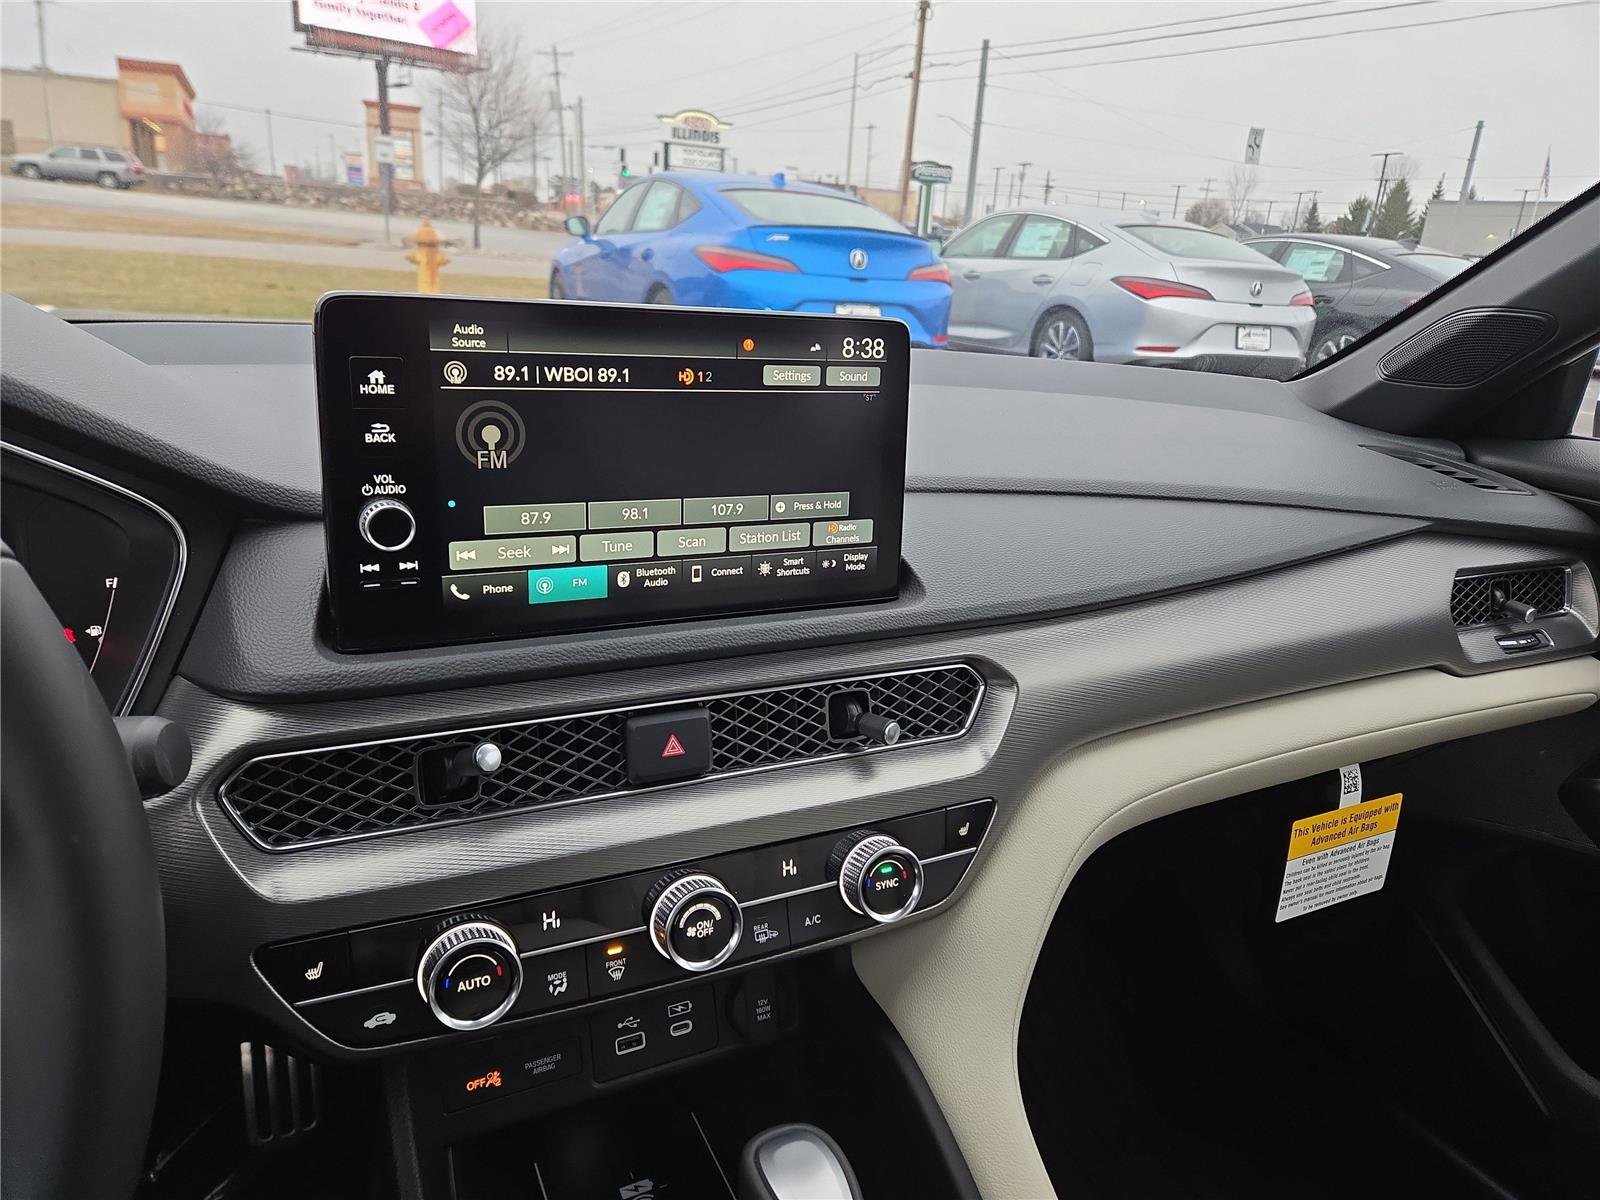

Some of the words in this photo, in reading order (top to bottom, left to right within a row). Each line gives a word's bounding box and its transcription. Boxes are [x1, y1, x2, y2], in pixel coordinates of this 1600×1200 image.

[453, 323, 484, 336] Audio
[451, 337, 486, 348] Source
[842, 337, 885, 359] 8:38
[494, 365, 529, 382] 89.1
[544, 366, 593, 383] WBOI
[597, 367, 630, 383] 89.1
[772, 369, 812, 383] Settings
[839, 370, 868, 382] Sound
[359, 383, 396, 395] HOME
[364, 432, 397, 444] BACK
[476, 450, 508, 470] FM
[373, 474, 395, 485] VOL
[374, 484, 407, 496] AUDIO
[711, 503, 744, 517] 107.9
[793, 501, 814, 511] Press
[815, 501, 822, 510] &
[823, 500, 842, 510] Hold
[520, 511, 552, 526] 87.9
[621, 507, 649, 521] 98.1
[839, 523, 857, 532] Radio
[678, 535, 706, 549] Scan
[739, 531, 779, 545] Station
[782, 530, 802, 542] List
[825, 534, 860, 544] Channels
[602, 539, 633, 553] Tune
[497, 545, 532, 560] Seek
[843, 552, 869, 563] Display
[783, 557, 805, 567] Smart
[845, 563, 866, 572] Mode
[636, 566, 677, 578] Bluetooth
[711, 566, 744, 577] Connect
[776, 567, 811, 577] Shortcuts
[572, 577, 588, 588] FM
[644, 577, 669, 588] Audio
[482, 583, 514, 595] Phone
[1294, 828, 1309, 839] This
[1311, 818, 1339, 834] Vehicle
[1340, 816, 1347, 826] is
[1349, 805, 1382, 823] Equipped
[1384, 802, 1399, 813] with
[1311, 829, 1346, 847] Advanced
[1347, 825, 1358, 836] Air
[1360, 820, 1378, 833] Bags
[1301, 855, 1315, 865] Even
[1316, 852, 1329, 861] with
[1329, 844, 1356, 857] Advanced
[1356, 841, 1365, 849] Air
[1366, 837, 1380, 847] Bags
[875, 878, 899, 891] SYNC
[696, 919, 714, 930] ON/
[804, 914, 822, 927] A/C
[696, 927, 714, 938] OFF
[753, 922, 769, 932] REAR
[605, 957, 627, 969] FRONT
[547, 971, 567, 981] MODE
[457, 974, 491, 993] AUTO
[757, 998, 769, 1006] 12V
[757, 1012, 771, 1021] MAX
[524, 1053, 562, 1070] PASSENGER
[533, 1062, 556, 1075] AIRBAG
[466, 1077, 486, 1092] OFF
